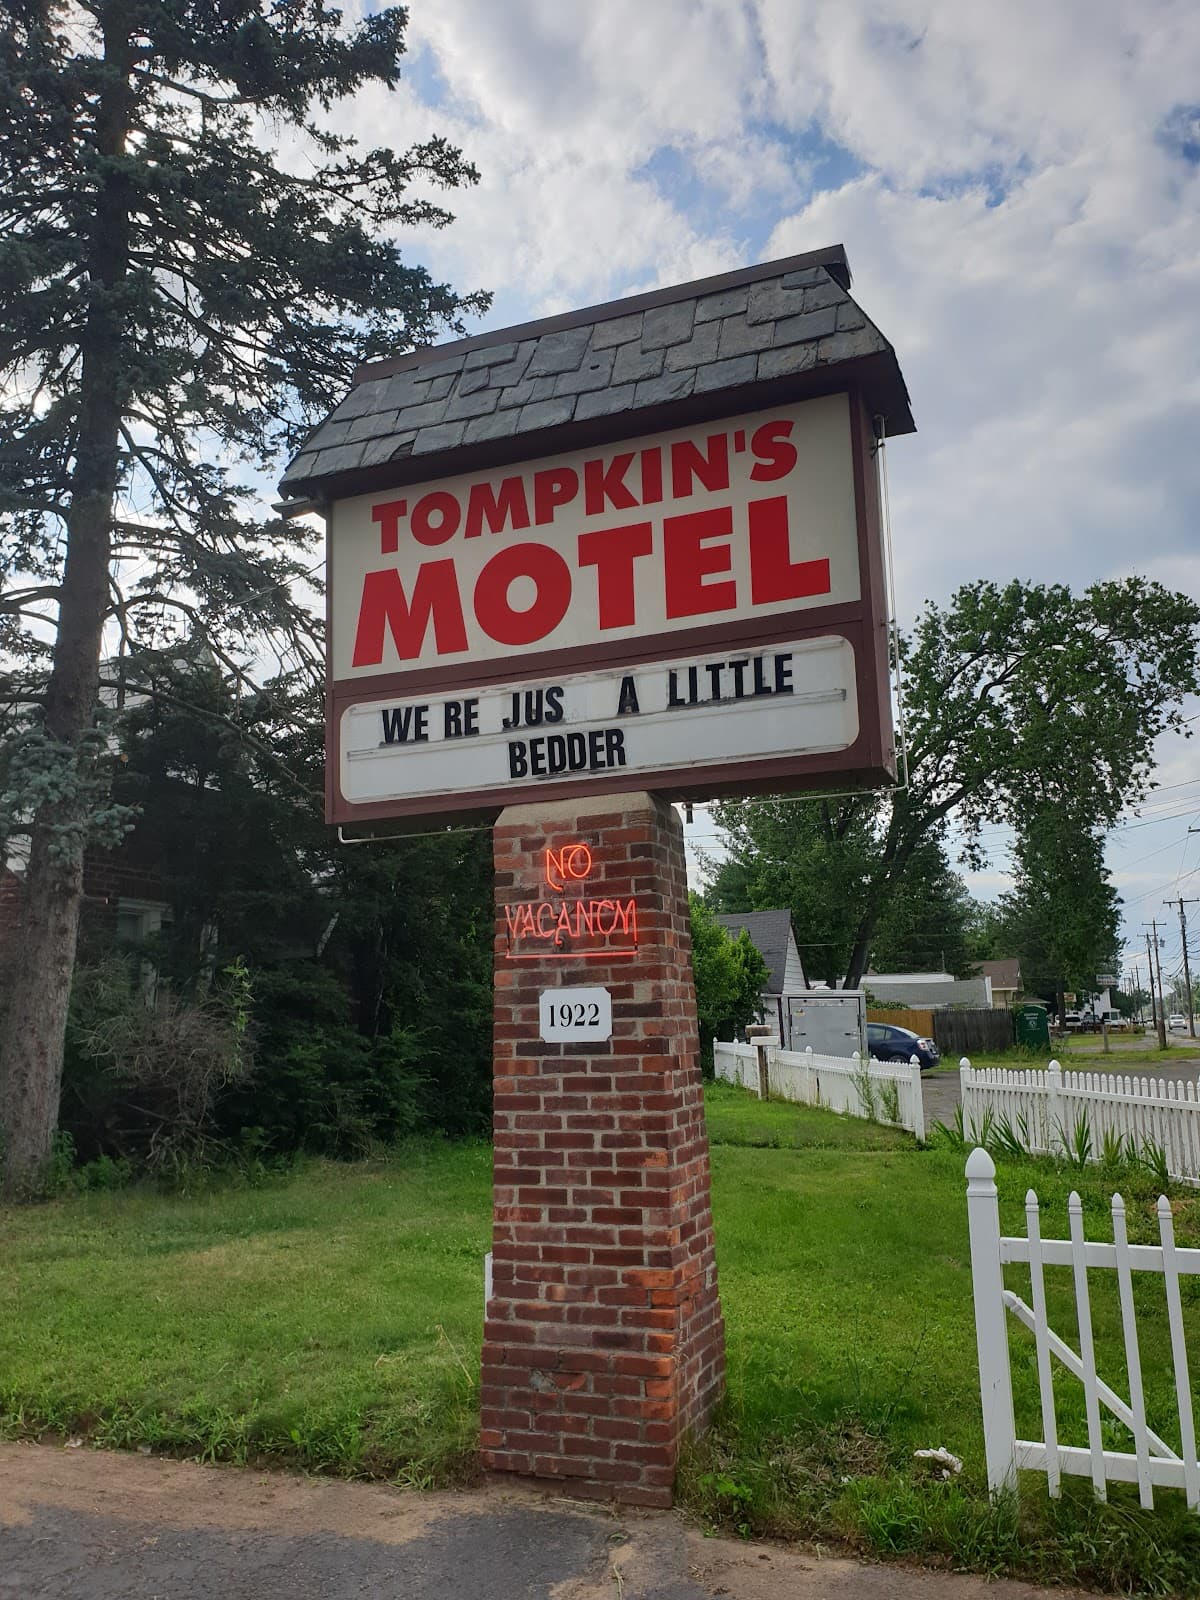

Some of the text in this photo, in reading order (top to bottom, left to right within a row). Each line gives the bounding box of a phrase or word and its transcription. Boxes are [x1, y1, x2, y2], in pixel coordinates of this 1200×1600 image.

[372, 420, 798, 554] TOMPKIN'S
[351, 495, 831, 668] MOTEL
[381, 653, 794, 745] WE RE JUS A LITTLE
[508, 728, 626, 779] BEDDER
[546, 843, 592, 891] NO
[548, 1003, 600, 1028] 1922
